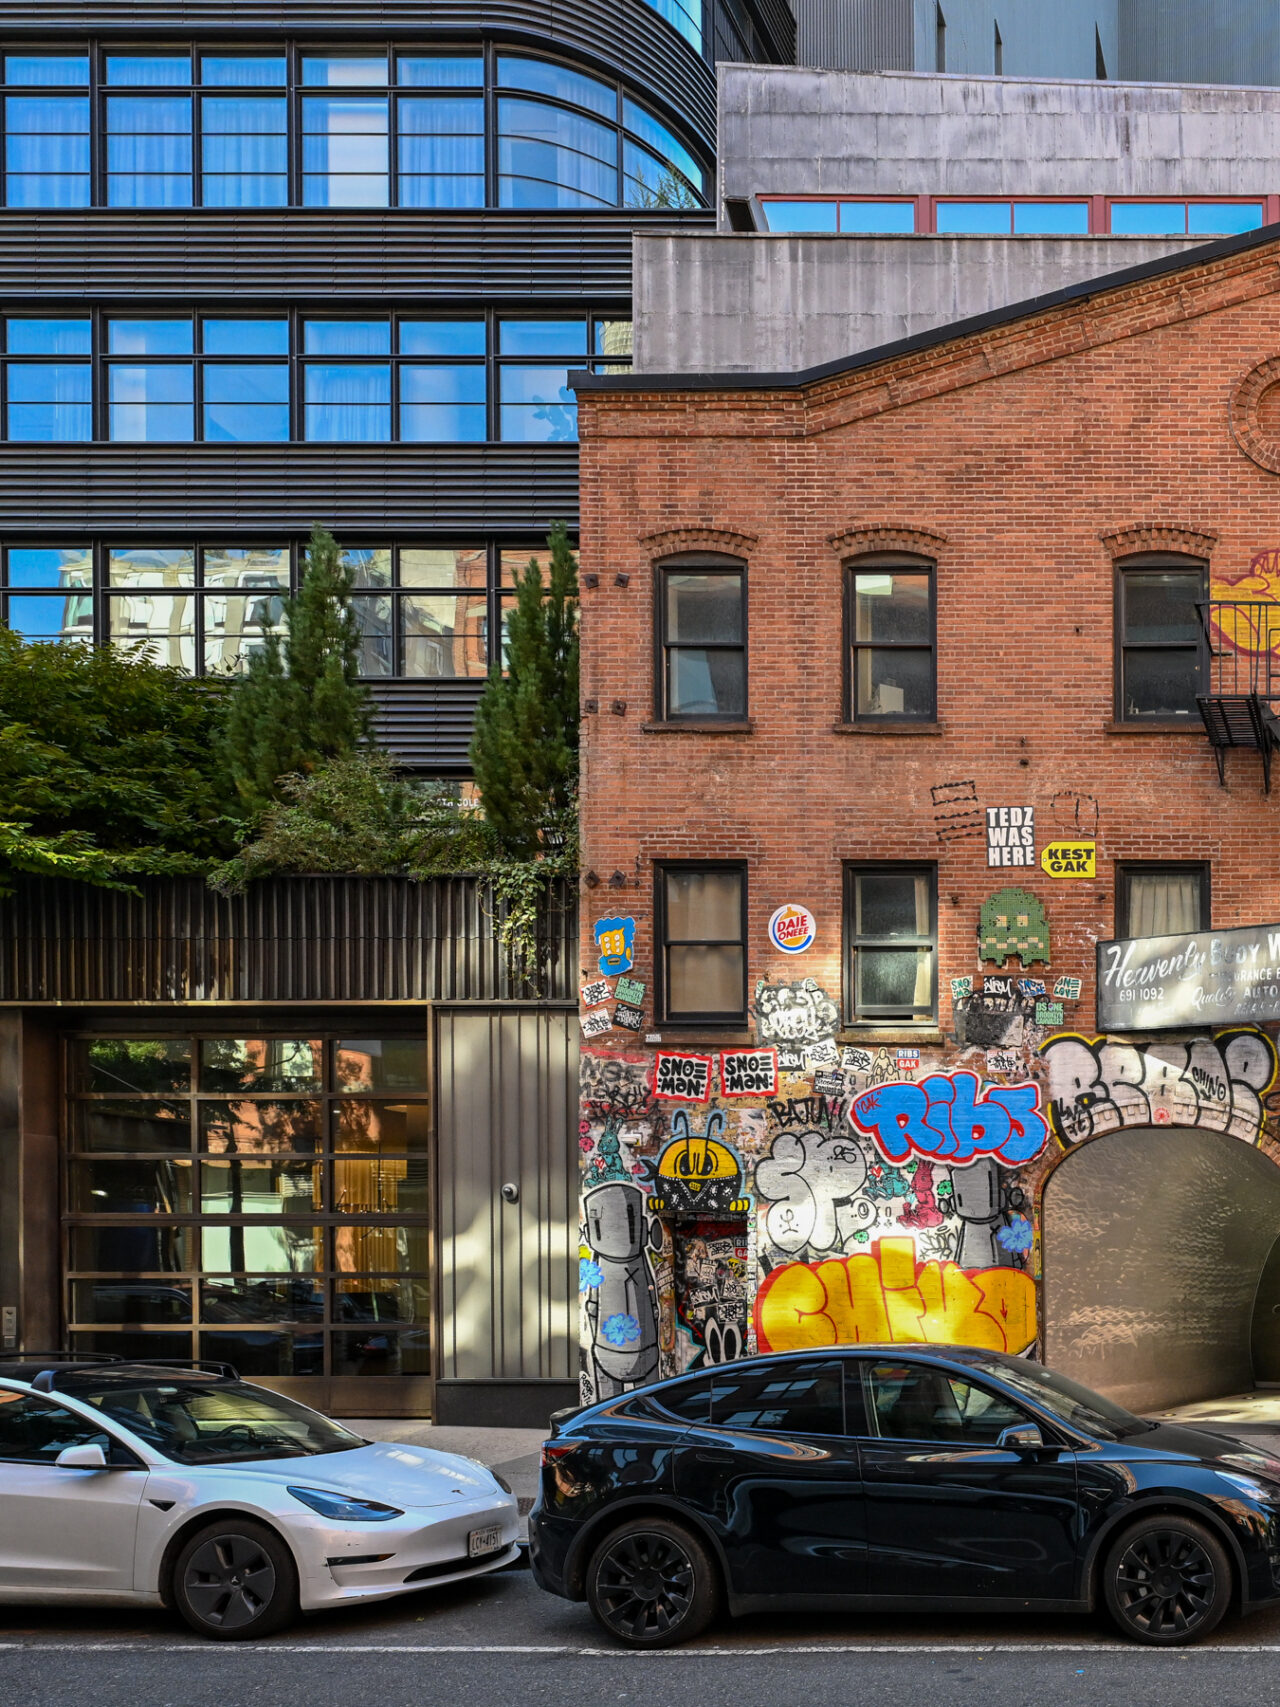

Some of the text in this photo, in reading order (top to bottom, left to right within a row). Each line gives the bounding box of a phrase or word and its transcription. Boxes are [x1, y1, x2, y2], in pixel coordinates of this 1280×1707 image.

[986, 806, 1034, 827] TEDZ
[988, 827, 1033, 847] WAS
[988, 846, 1035, 867] HERE
[1048, 848, 1095, 860] KEST
[1050, 861, 1089, 873] GAK
[777, 914, 808, 934] DAIE
[778, 926, 809, 941] ONEEE
[1104, 939, 1208, 988] Heavenly
[1120, 988, 1164, 1002] 691 1092
[898, 1050, 919, 1059] RIBS
[898, 1060, 917, 1068] GAK
